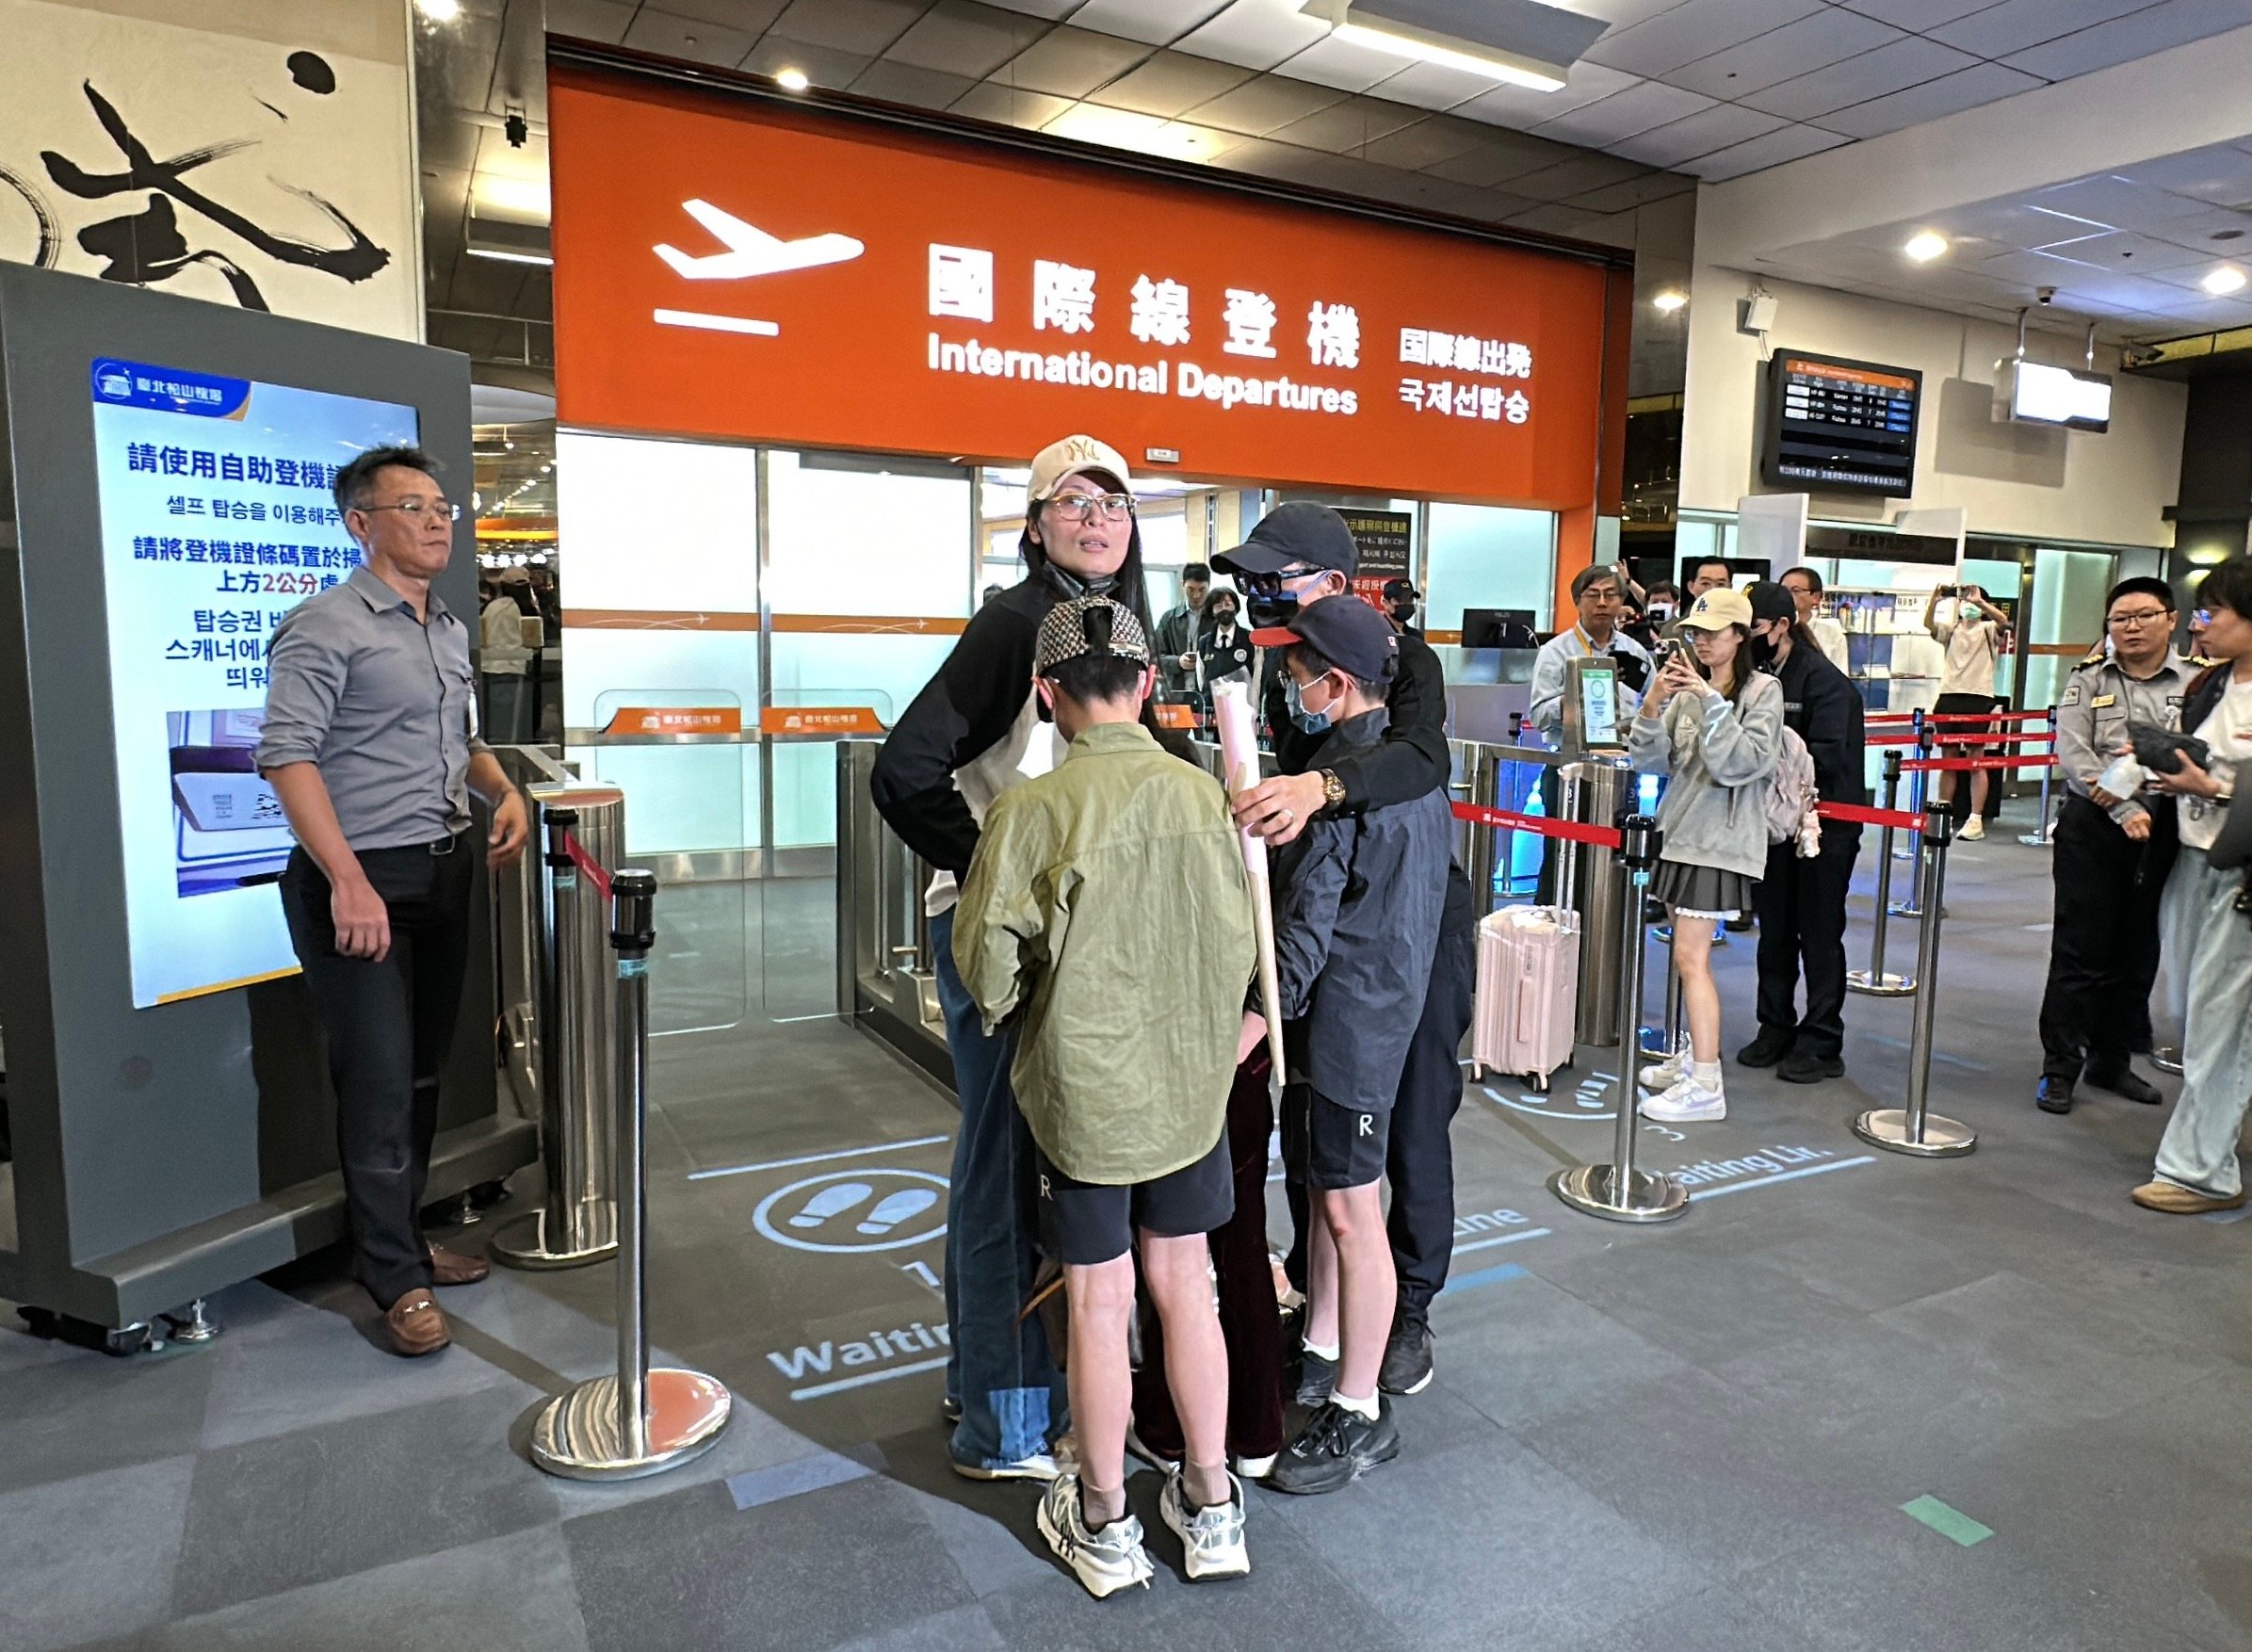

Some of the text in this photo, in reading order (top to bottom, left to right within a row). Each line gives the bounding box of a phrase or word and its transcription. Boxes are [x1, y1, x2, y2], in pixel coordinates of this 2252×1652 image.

[929, 243, 1361, 369] 國際線登機
[929, 332, 1358, 416] International Departures
[1399, 378, 1531, 425] 국제선탑승
[167, 494, 341, 526] 셀프 탑승을 이용해주
[133, 535, 362, 569] 請將登機證條碼置於掃
[193, 608, 263, 634] 탑승권
[1358, 1113, 1374, 1137] R
[1668, 1155, 1785, 1185] aiting
[1040, 1174, 1054, 1200] R
